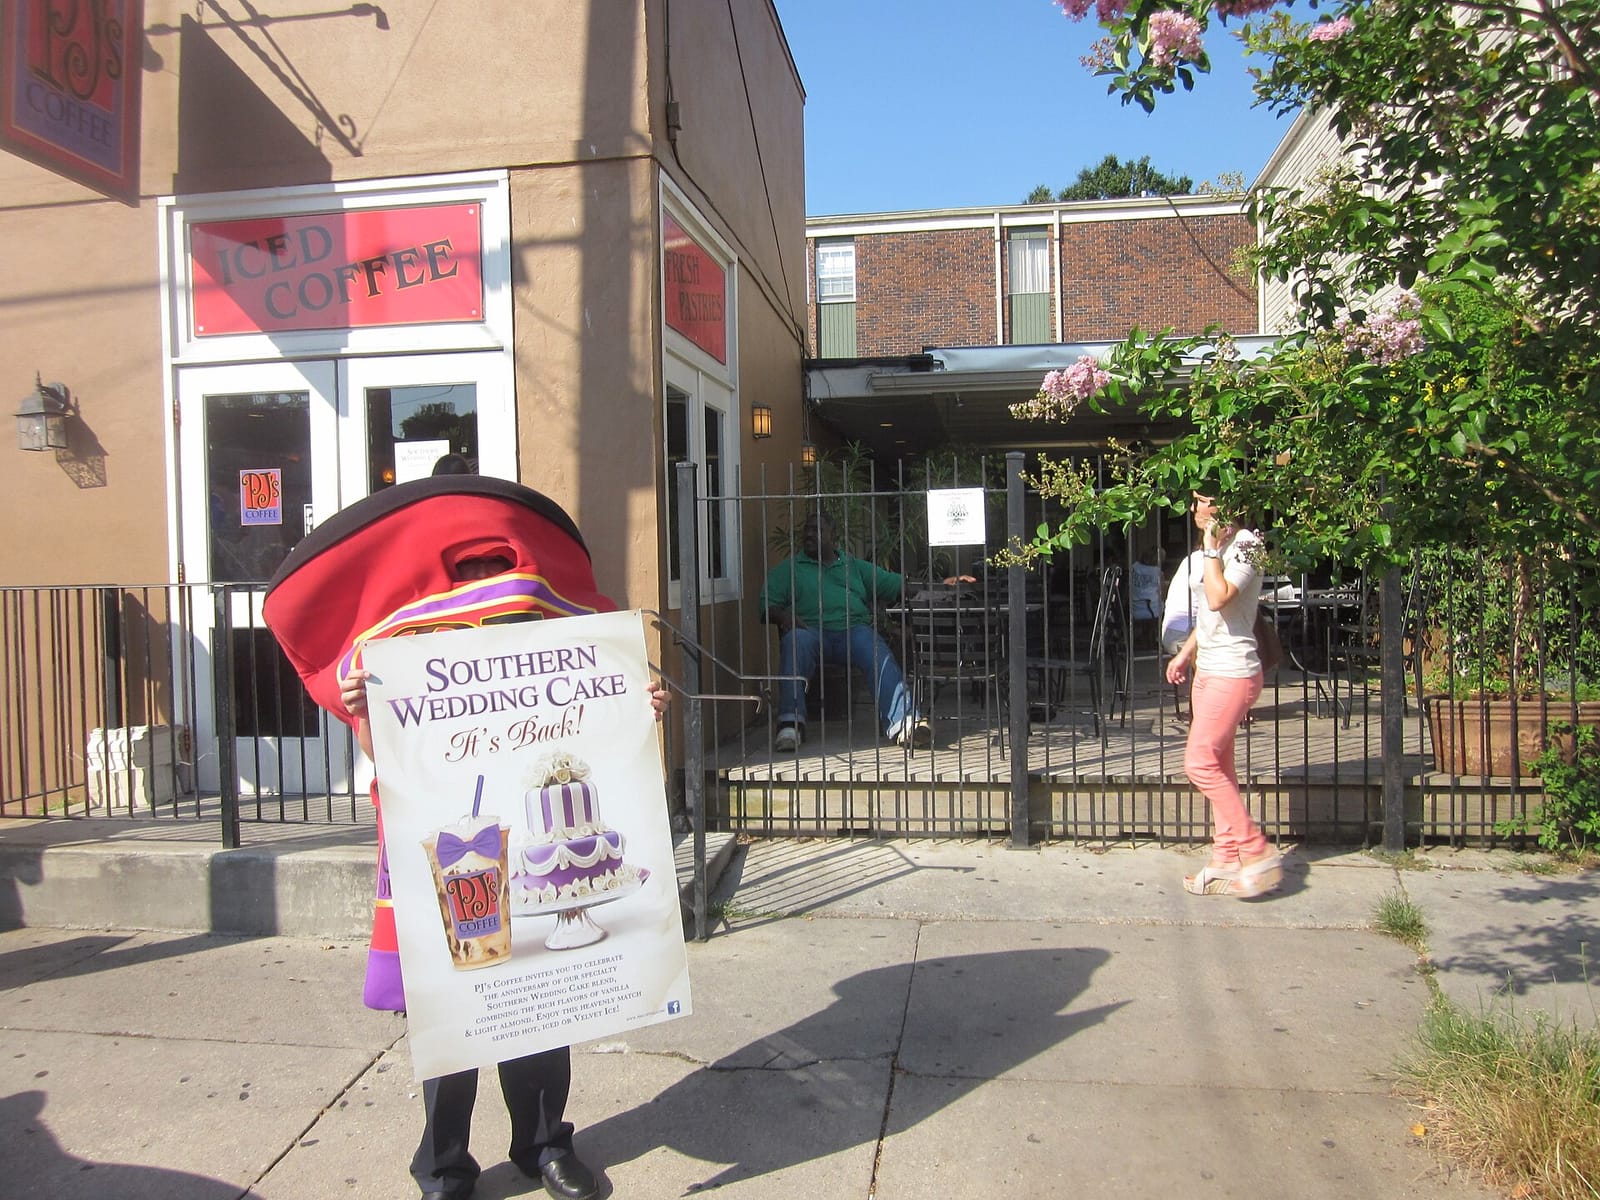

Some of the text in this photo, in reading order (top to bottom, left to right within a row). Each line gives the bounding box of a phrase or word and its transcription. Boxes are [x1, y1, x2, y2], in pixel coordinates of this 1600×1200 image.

[25, 81, 113, 148] COFFEE
[218, 224, 333, 286] ICED
[665, 251, 699, 285] FRESH
[264, 238, 459, 320] COFFEE
[679, 290, 722, 321] PASTRIES
[242, 472, 279, 510] PJ's
[245, 510, 278, 519] COFFEE
[425, 645, 598, 693] SOUTHERN
[387, 674, 628, 729] WEDDING CAKE
[445, 704, 584, 763] It's Back!
[447, 872, 498, 922] PJ's
[458, 917, 498, 933] COFFEE
[484, 993, 498, 1002] THE
[501, 981, 549, 998] ANNIVERSARY
[564, 975, 579, 983] OUR
[581, 966, 618, 979] SPECIALTY
[494, 976, 523, 988] COFFEE
[525, 971, 554, 981] INVITES
[555, 966, 570, 976] YOU
[573, 963, 583, 971] TO
[584, 955, 624, 968] CELEBRATE
[465, 1029, 472, 1038] &
[474, 1025, 497, 1036] LIGHT
[536, 1010, 560, 1022] ENJOY
[562, 1006, 579, 1015] THIS
[580, 997, 616, 1011] HEAVENLY
[617, 991, 642, 1002] MATCH
[475, 1010, 519, 1025] COMBINING
[520, 1005, 536, 1014] THE
[538, 1001, 556, 1011] RICH
[557, 994, 588, 1006] FLAVORS
[601, 984, 630, 995] VANILLA
[486, 997, 528, 1011] SOUTHERN
[530, 988, 567, 1001] WEDDING
[569, 983, 590, 993] CAKE
[492, 1031, 520, 1042] SERVED
[542, 1021, 560, 1030] ICED
[574, 1010, 602, 1022] VELVET
